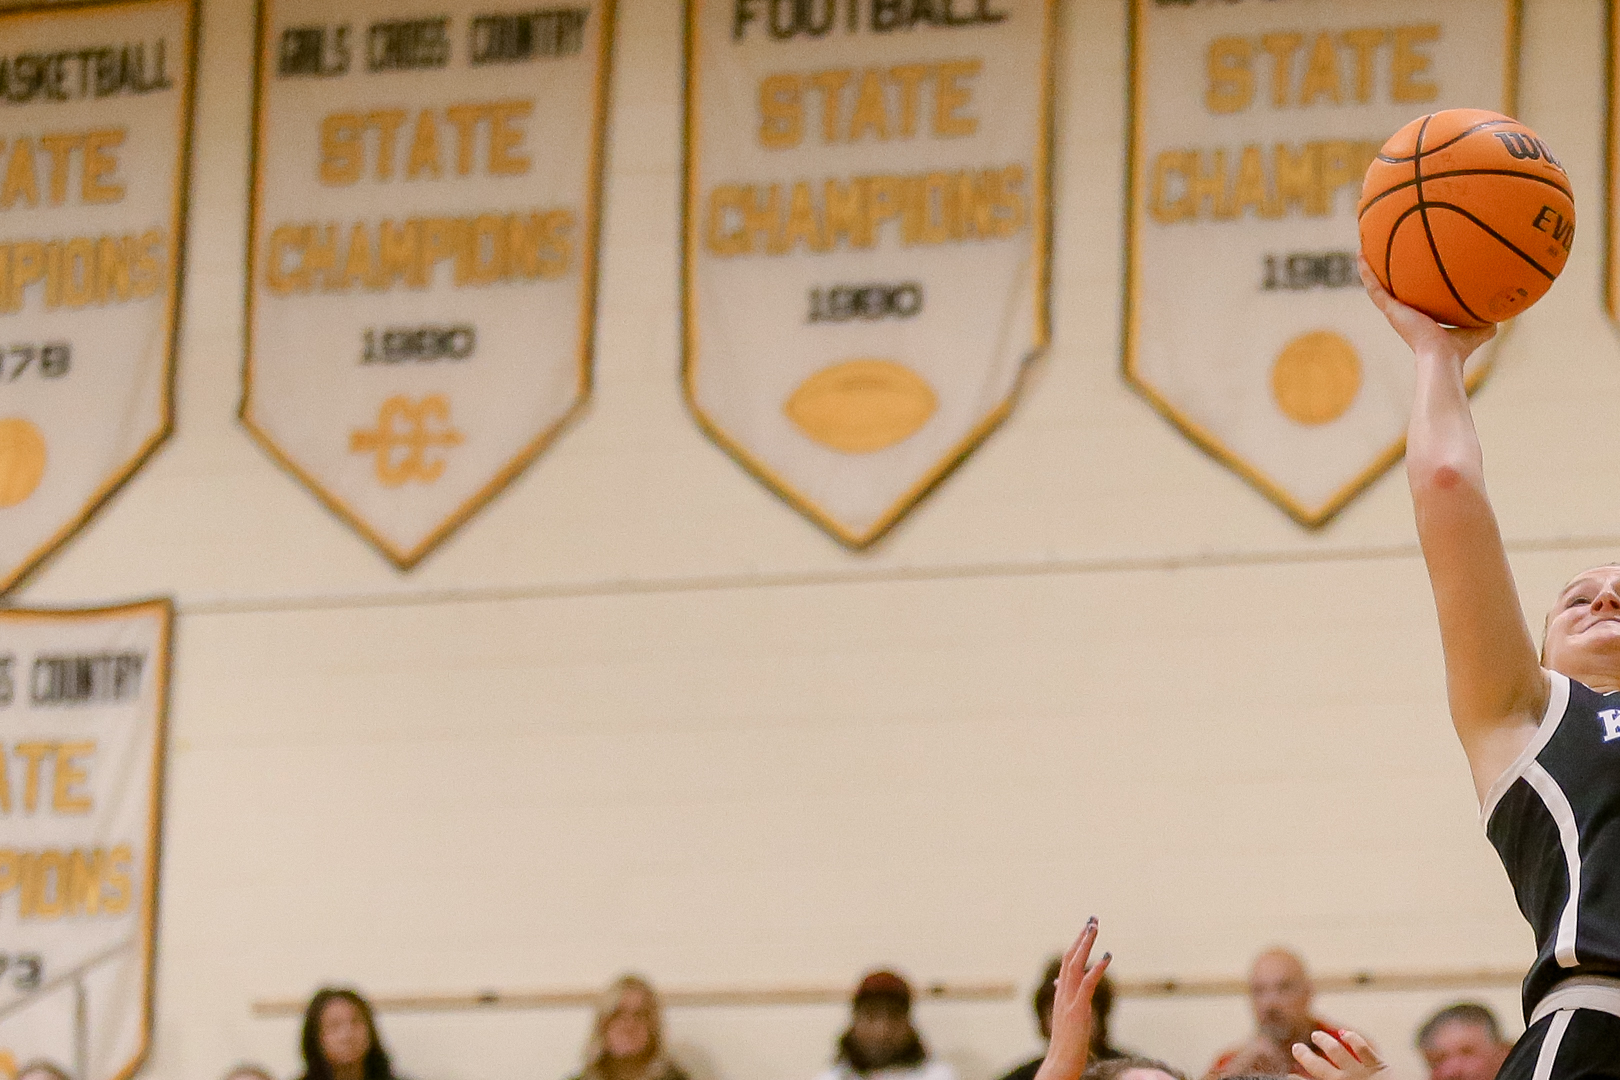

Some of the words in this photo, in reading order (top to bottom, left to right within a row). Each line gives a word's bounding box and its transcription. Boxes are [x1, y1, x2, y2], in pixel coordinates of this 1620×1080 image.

[757, 59, 984, 148] STATE
[1204, 24, 1441, 113] STATE
[318, 101, 535, 187] STATE
[264, 209, 575, 296] CHAMPIONS
[705, 165, 1027, 258] CHAMPIONS
